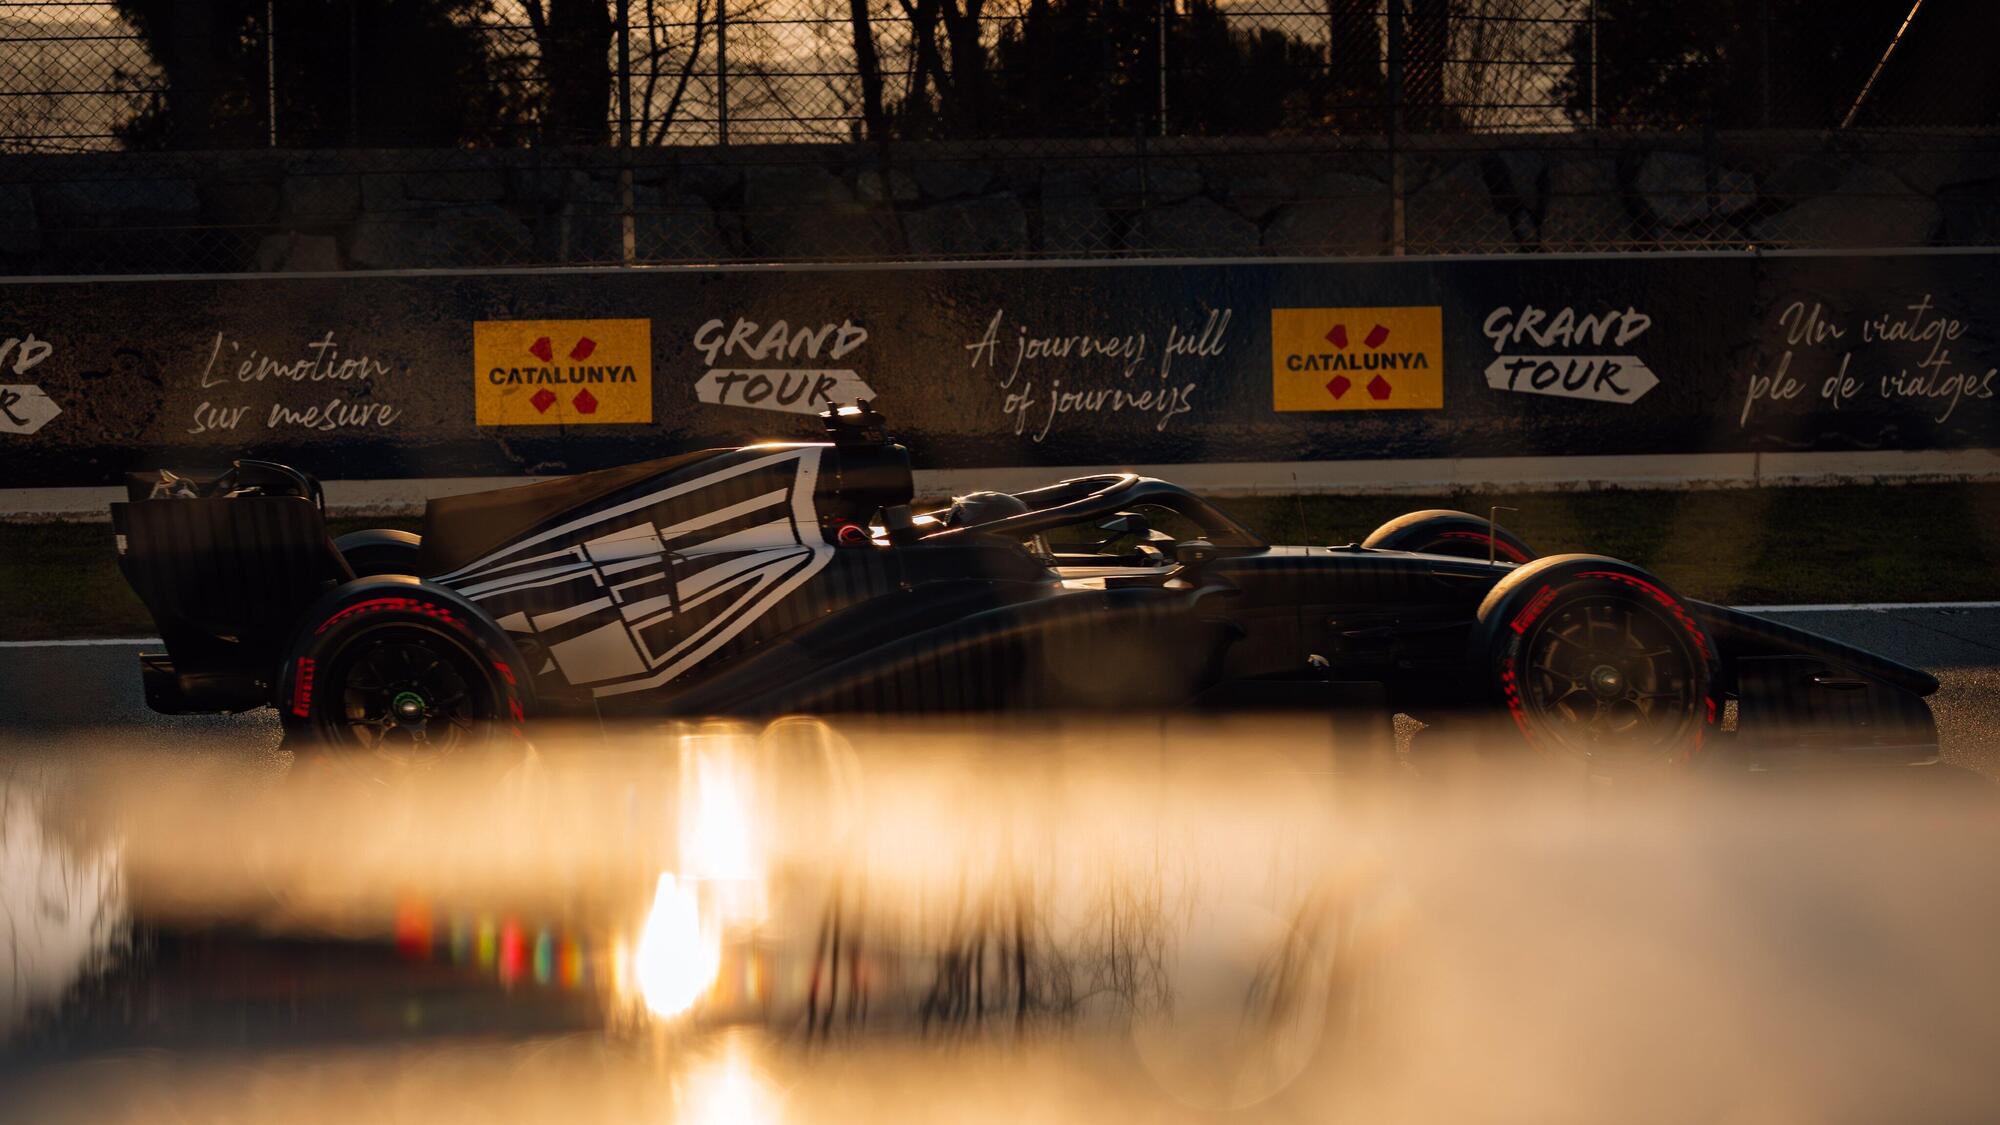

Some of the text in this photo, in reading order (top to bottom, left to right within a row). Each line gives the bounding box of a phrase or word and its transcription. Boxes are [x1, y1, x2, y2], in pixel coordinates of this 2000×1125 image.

[693, 317, 869, 366] GRAND
[965, 308, 1232, 389] A journey full
[1482, 305, 1653, 353] GRAND
[1778, 294, 1968, 368] Un viatge
[488, 366, 637, 386] CATALUNYA
[1287, 352, 1429, 371] CATALUNYA
[1505, 357, 1631, 396] TOUR
[715, 370, 838, 406] TOUR
[1003, 379, 1196, 443] of journeys
[1740, 349, 1998, 429] ple de viatges
[186, 398, 402, 434] sur mesure
[291, 656, 318, 718] PIRELLI
